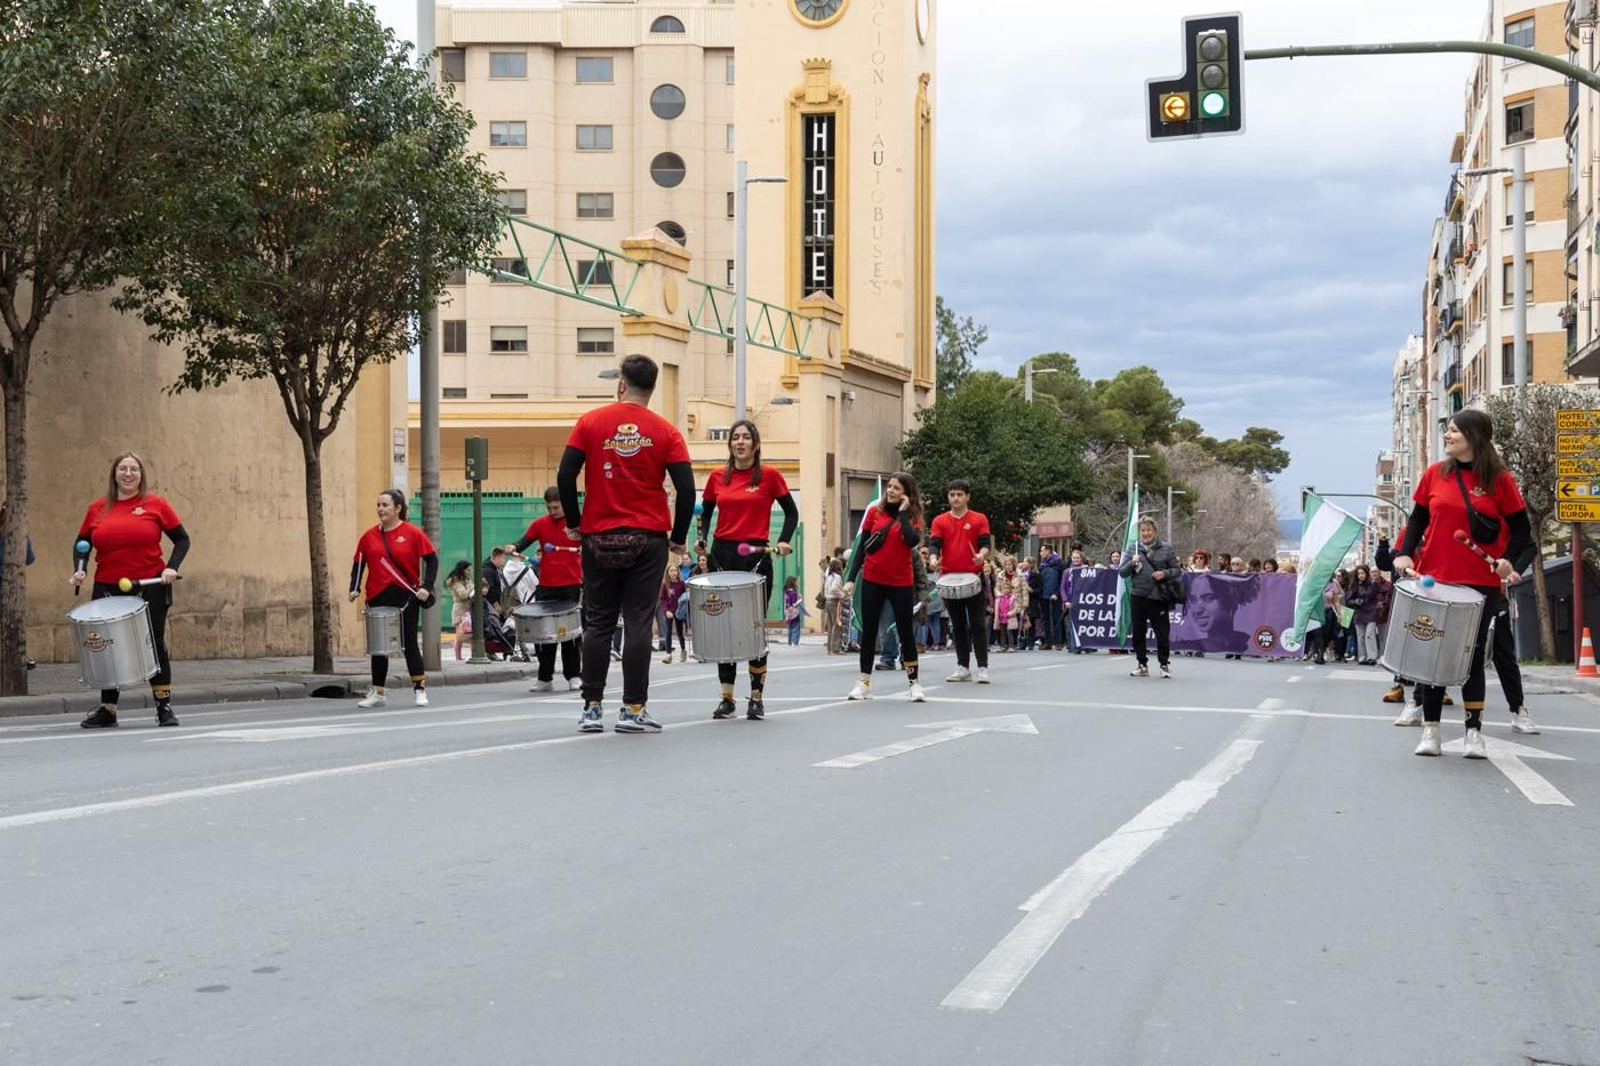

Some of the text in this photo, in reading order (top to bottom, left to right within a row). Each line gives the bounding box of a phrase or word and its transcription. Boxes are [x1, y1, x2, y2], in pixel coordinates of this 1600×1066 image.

[812, 122, 826, 282] HOTE
[872, 133, 885, 294] AUTOBUSES
[1561, 503, 1588, 511] HOTEL
[1560, 511, 1595, 519] EUROPA
[1080, 568, 1096, 578] 8M
[1078, 593, 1104, 605] LOS
[1078, 610, 1094, 621] DE
[1078, 626, 1105, 637] POR
